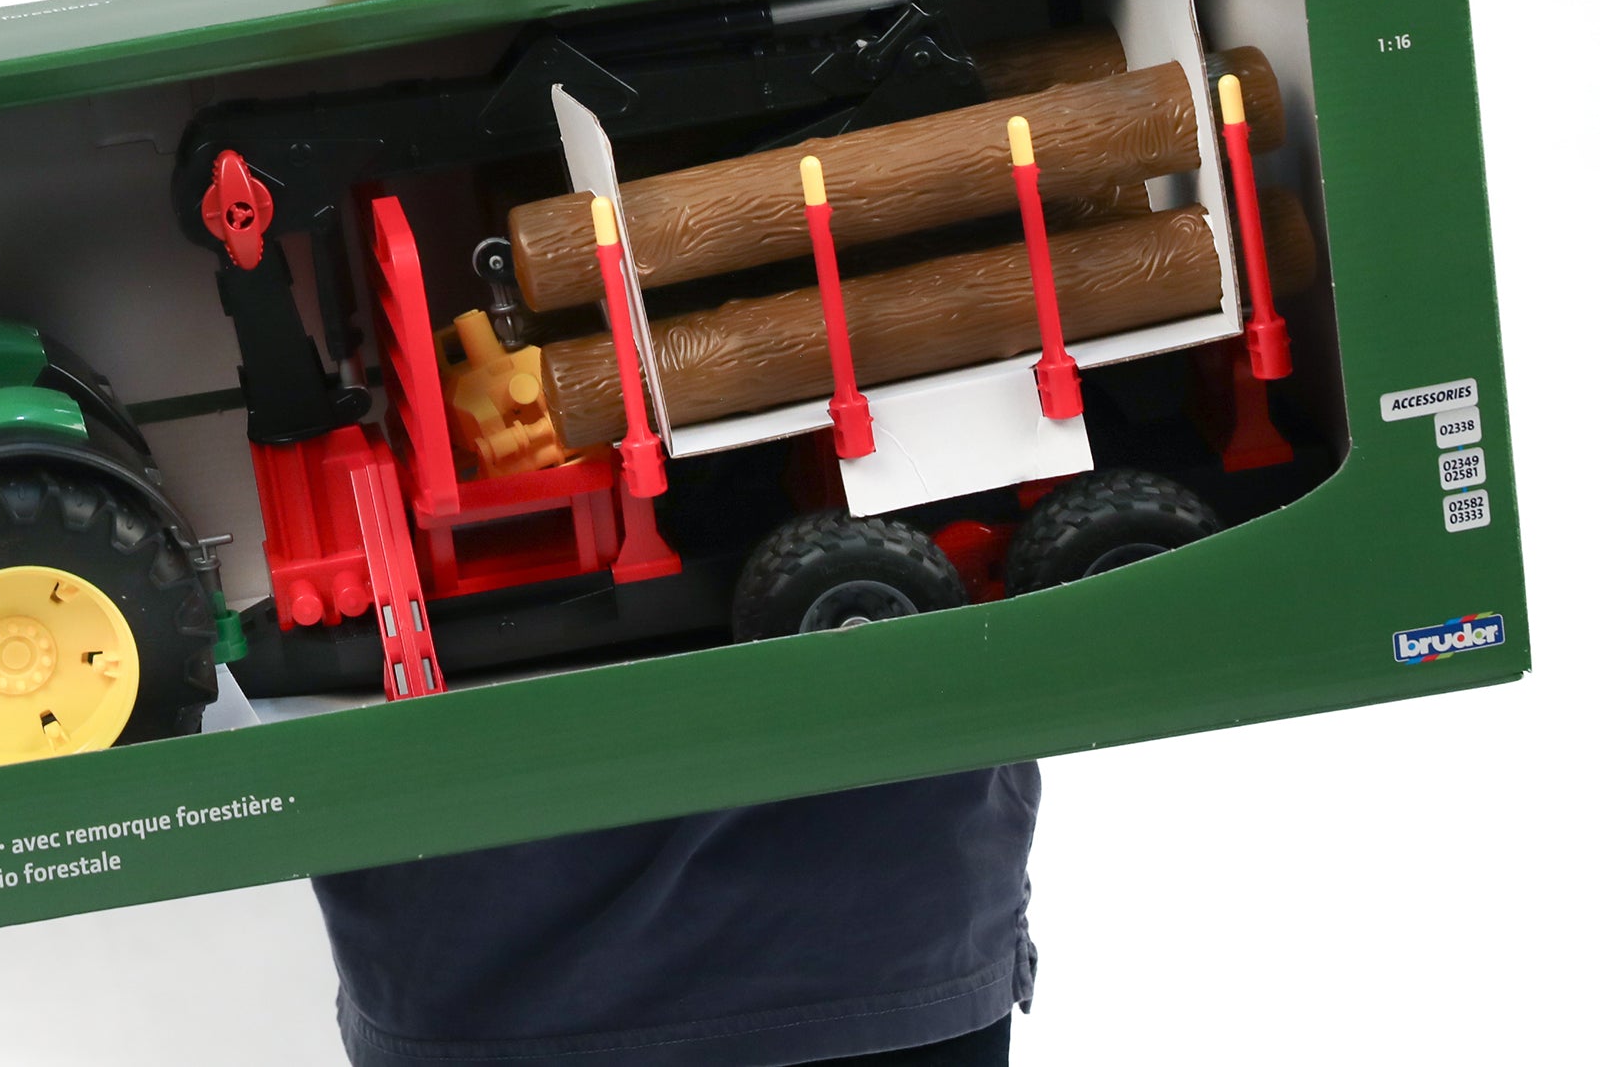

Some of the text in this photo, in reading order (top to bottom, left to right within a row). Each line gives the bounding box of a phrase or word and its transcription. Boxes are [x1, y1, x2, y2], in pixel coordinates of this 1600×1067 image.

[1392, 386, 1472, 411] ACCESSORIES
[1440, 420, 1475, 436] 02338
[1443, 455, 1480, 472] 02349
[1444, 467, 1478, 483] 02581
[1448, 496, 1484, 513] 02582
[1449, 508, 1484, 524] 03333
[1398, 622, 1499, 659] bruder
[11, 834, 61, 855] avec
[65, 816, 172, 846] remorque
[175, 795, 283, 828] forestière
[23, 850, 121, 884] forestale
